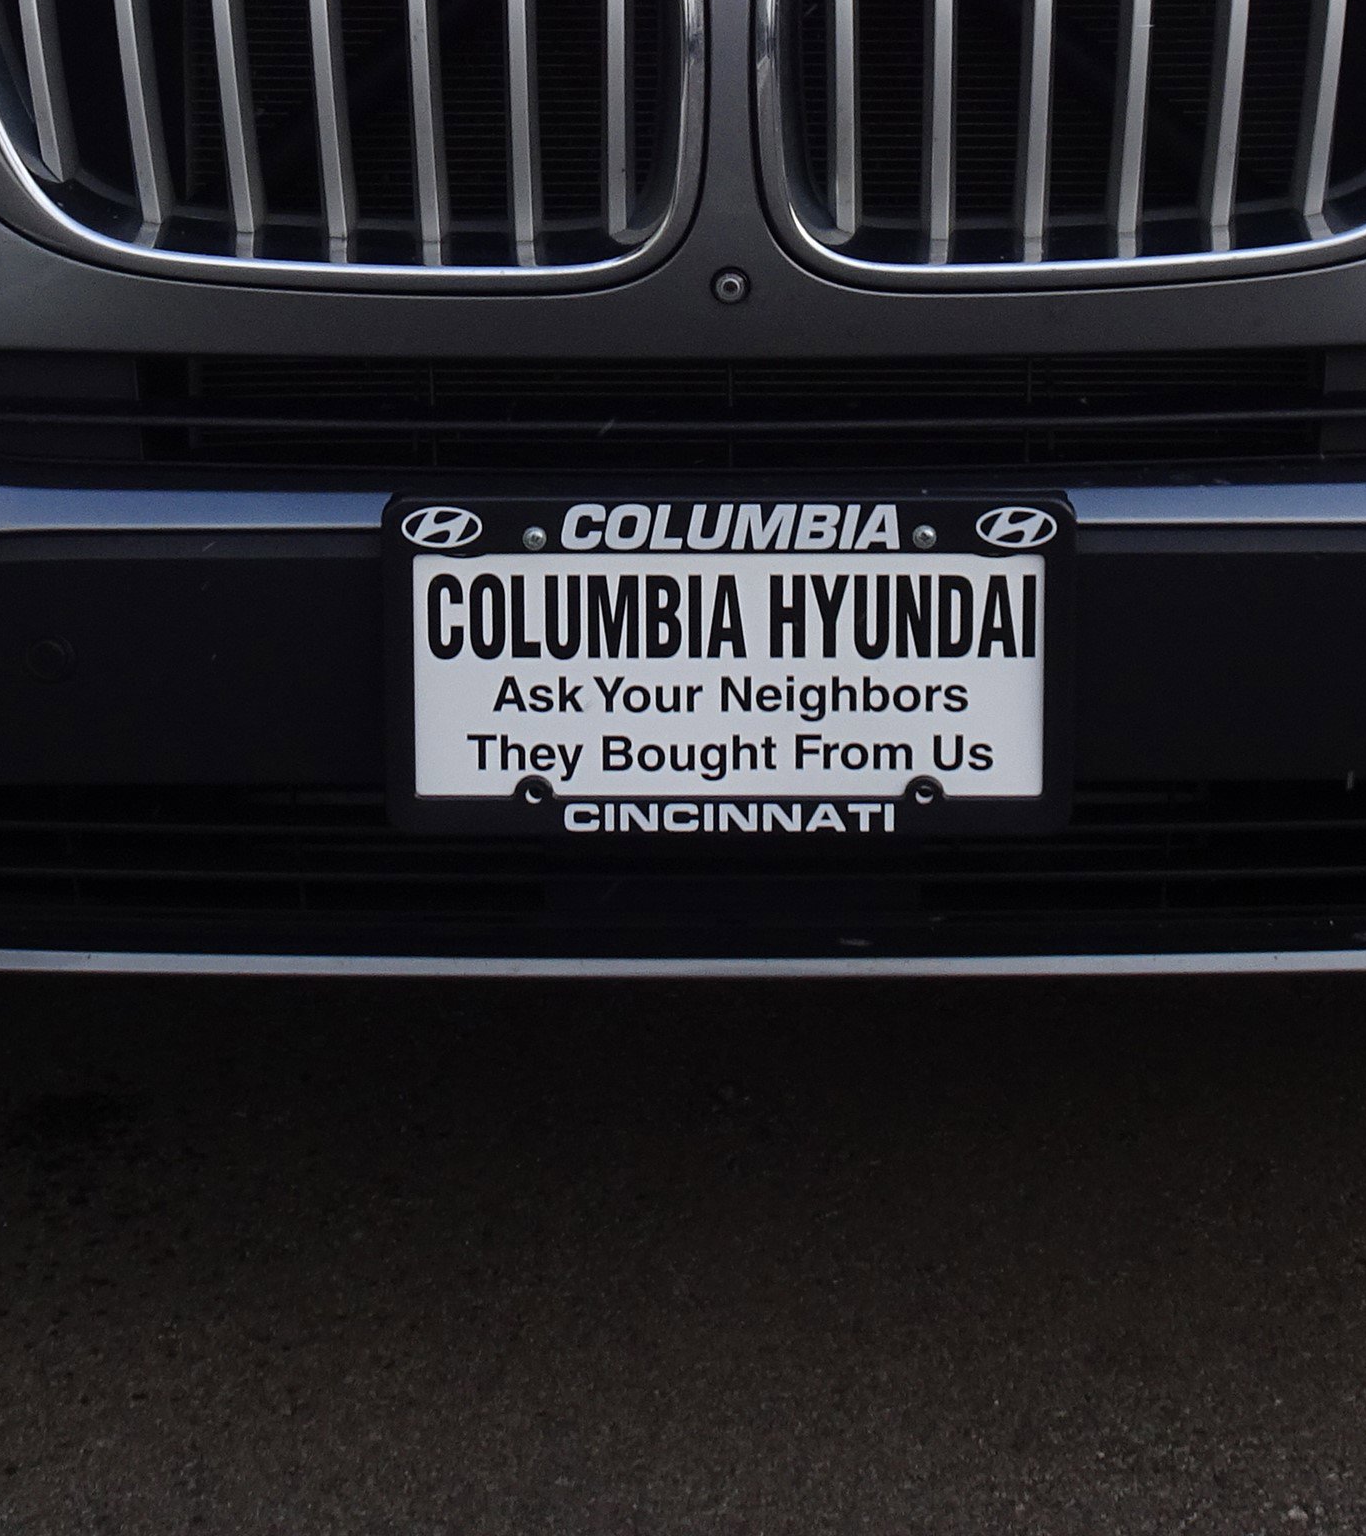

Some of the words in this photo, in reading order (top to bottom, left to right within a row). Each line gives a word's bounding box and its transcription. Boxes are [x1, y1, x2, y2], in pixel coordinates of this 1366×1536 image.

[560, 503, 901, 550] COLUMBIA
[427, 573, 747, 660] COLUMBIA
[769, 574, 1036, 659] HYUNDAI
[492, 675, 584, 713] Ask
[593, 676, 704, 714] Your
[720, 675, 969, 722] Neighbors
[466, 734, 584, 780] They
[602, 734, 777, 780] Bought
[795, 734, 914, 771] From
[932, 734, 994, 771] Us
[563, 803, 895, 832] CINCINNATI
